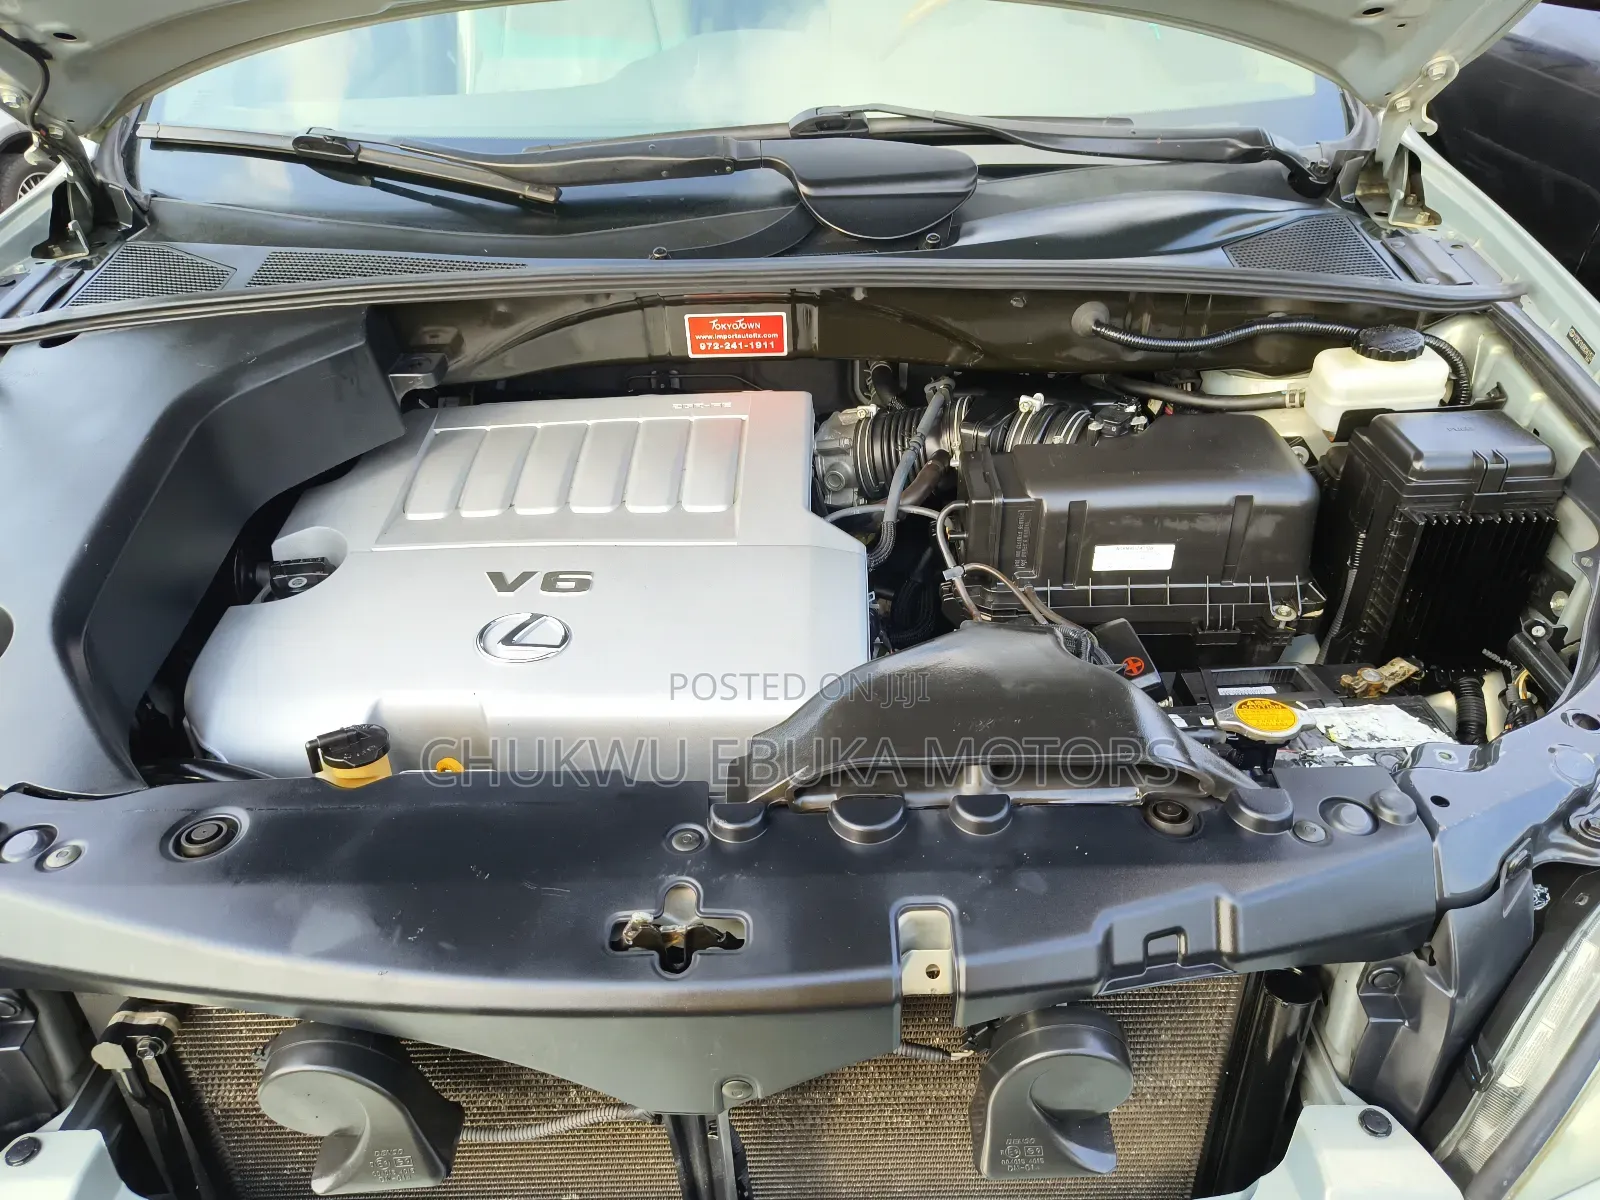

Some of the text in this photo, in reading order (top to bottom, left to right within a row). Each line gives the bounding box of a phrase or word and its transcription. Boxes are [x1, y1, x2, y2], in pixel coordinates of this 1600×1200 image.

[695, 332, 779, 341] www.importautofix.com
[699, 341, 775, 350] 972-241-1911
[485, 570, 594, 595] V6
